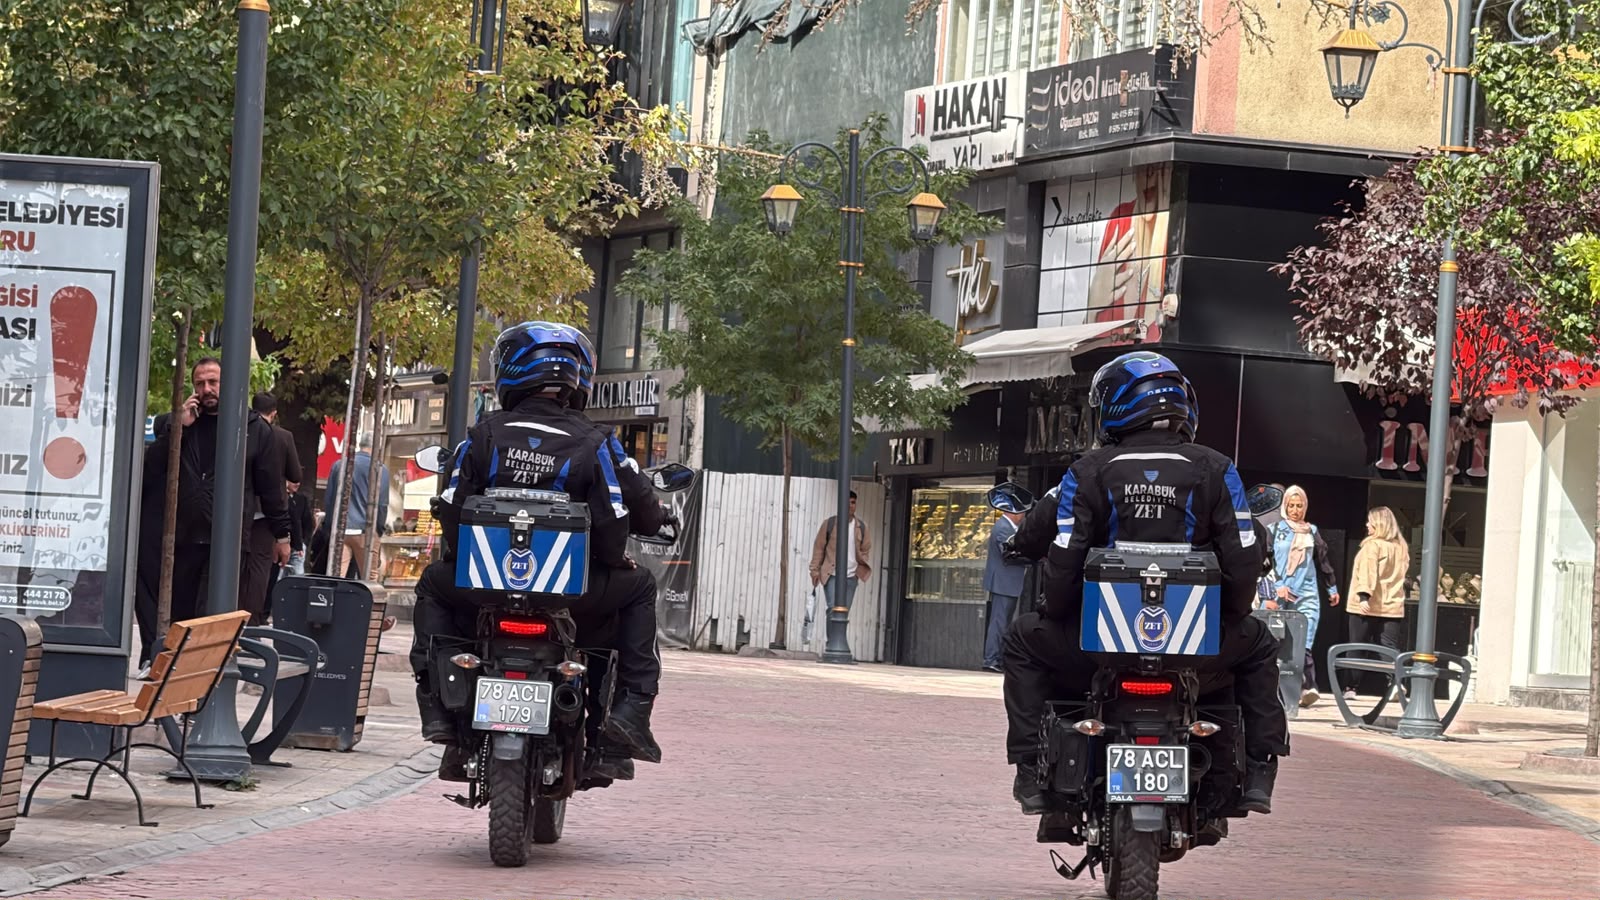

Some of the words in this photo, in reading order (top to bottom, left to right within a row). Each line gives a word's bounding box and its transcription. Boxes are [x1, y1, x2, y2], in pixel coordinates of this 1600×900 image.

[1054, 65, 1100, 107] ideal
[933, 77, 1008, 132] HAKAN
[953, 143, 983, 168] YAPI
[0, 230, 36, 252] RU
[0, 383, 32, 407] İZİ
[0, 453, 28, 475] IZ
[506, 447, 555, 466] KARABÜK
[512, 470, 541, 485] ZET
[1124, 484, 1176, 498] KARABÜK
[0, 506, 32, 519] üncel
[35, 508, 80, 523] tutunuz,
[1134, 504, 1166, 519] ZET
[512, 562, 528, 570] ZET
[23, 589, 41, 598] 444
[43, 591, 53, 599] 21
[54, 591, 66, 600] 78
[1144, 622, 1162, 630] ZET
[480, 682, 504, 700] 78
[507, 683, 547, 704] ACL
[499, 706, 532, 723] 179
[1111, 749, 1136, 769] 78
[1141, 749, 1184, 769] ACL
[1134, 773, 1169, 792] 180
